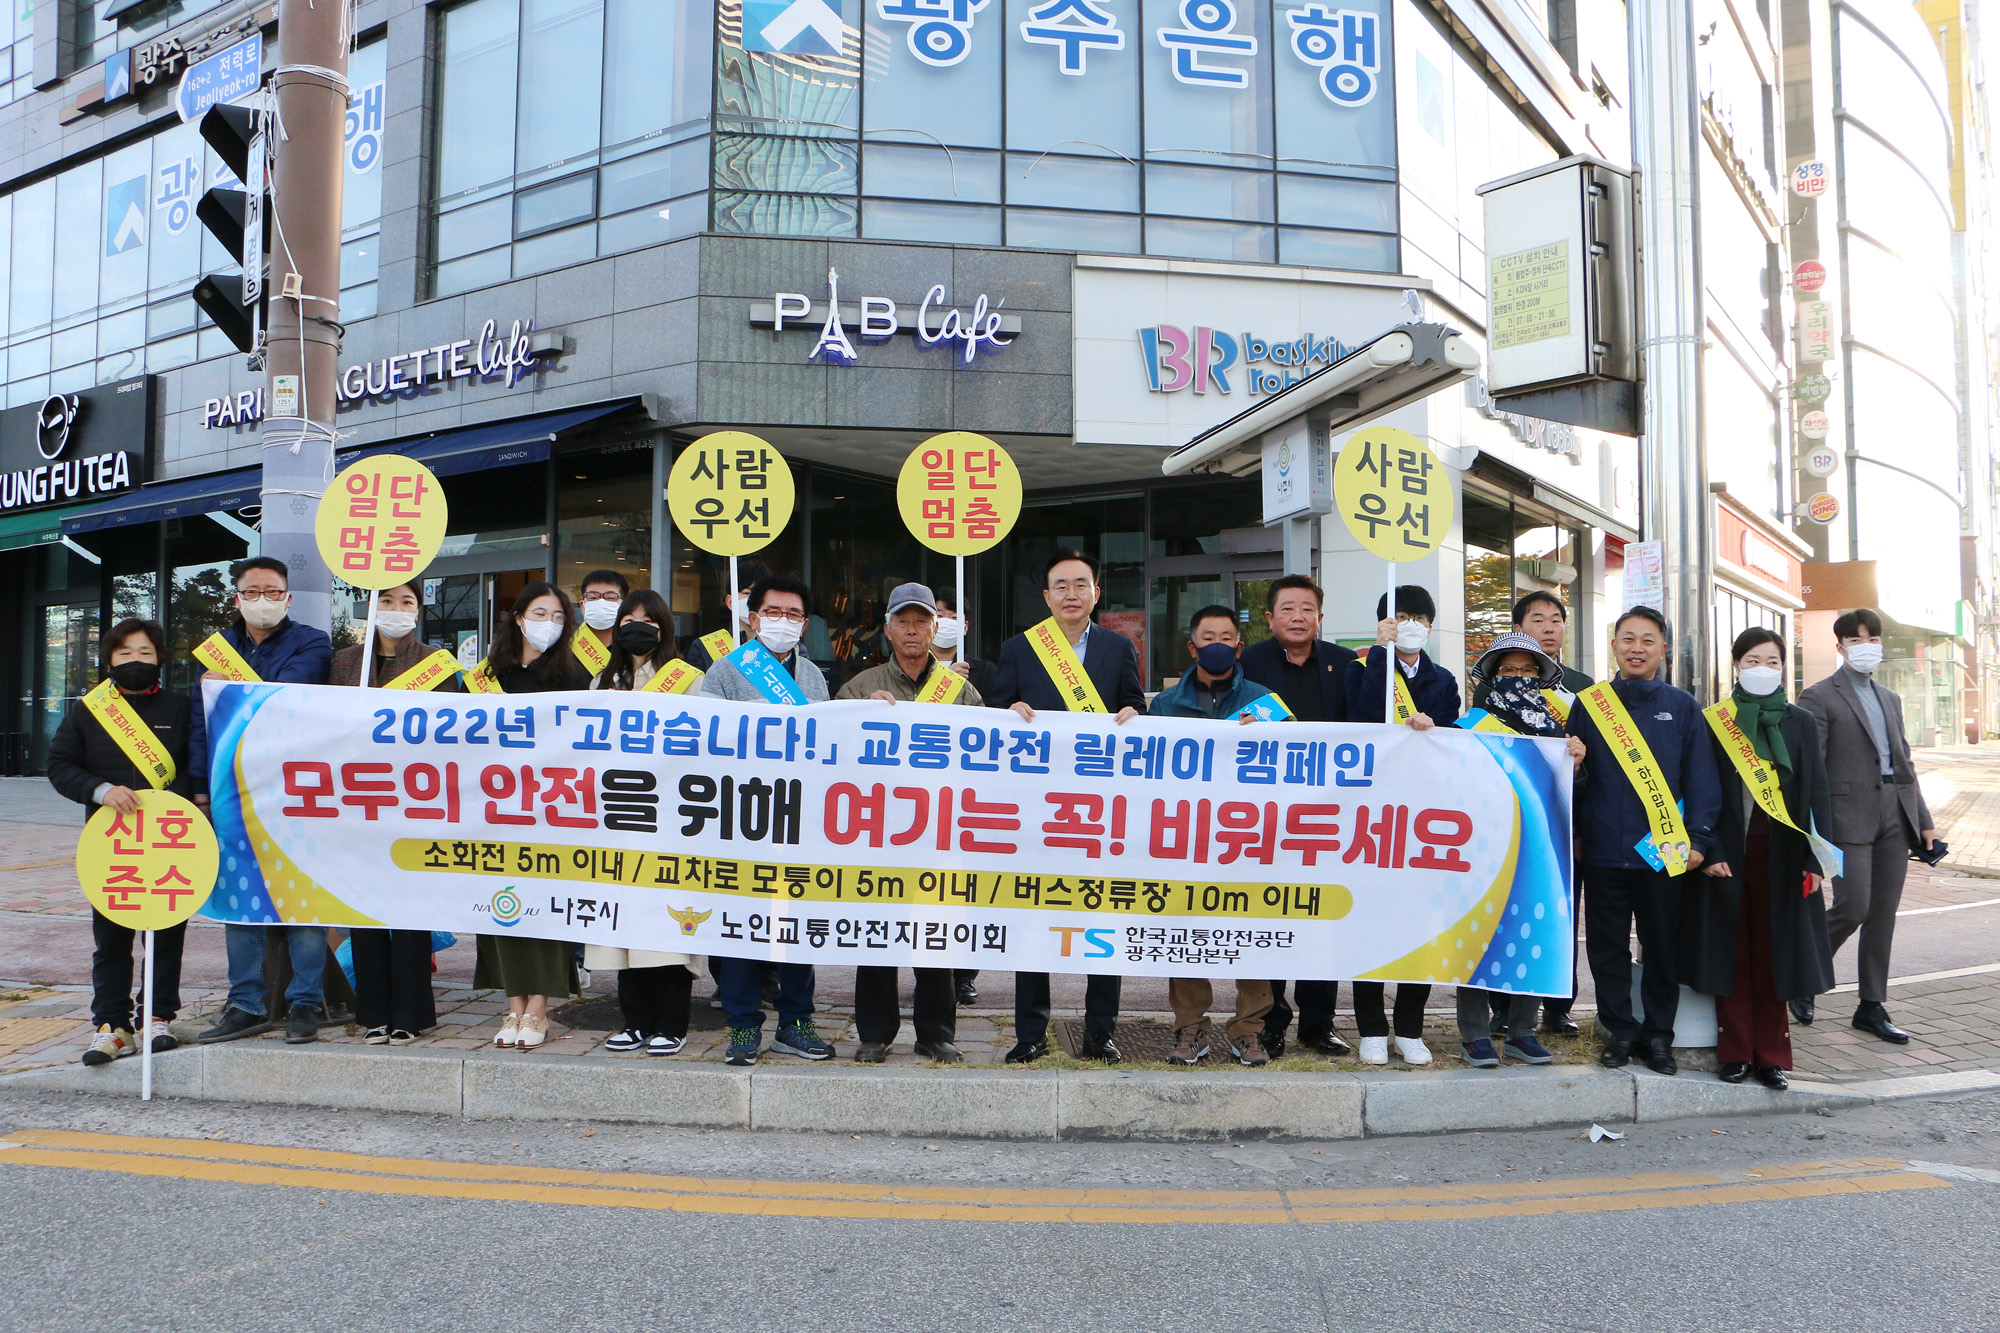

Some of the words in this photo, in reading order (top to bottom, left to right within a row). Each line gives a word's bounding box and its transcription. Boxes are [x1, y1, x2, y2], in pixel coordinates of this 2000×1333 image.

[219, 43, 257, 80] 전력로
[195, 71, 256, 111] Jeollyeok-ro
[1795, 162, 1824, 180] 성형
[1796, 178, 1826, 193] 비만
[1500, 255, 1524, 269] CCTV
[1526, 250, 1540, 263] 설치
[1543, 245, 1559, 259] 안내
[1534, 279, 1549, 290] 사거리
[917, 284, 1013, 363] Café
[1807, 303, 1830, 358] 우리약국
[205, 387, 266, 428] PARI
[337, 339, 472, 402] GUETTE
[476, 318, 537, 389] Café
[1137, 324, 1240, 395] BR
[1800, 383, 1830, 399] 비빔밥
[498, 450, 528, 461] SANDWICH
[1315, 430, 1325, 456] 다기능
[1813, 455, 1832, 468] BR
[83, 450, 130, 493] TEA
[690, 448, 774, 490] 사람
[921, 448, 1001, 491] 일단
[1277, 477, 1293, 497] 나주시
[1355, 441, 1434, 496] 사람
[345, 472, 429, 518] 일단
[1811, 498, 1836, 510] BURGER
[1812, 503, 1837, 517] KING
[690, 497, 771, 539] 우선
[922, 496, 1001, 539] 멈춤
[1354, 493, 1430, 549] 우선
[339, 521, 422, 573] 멈춤
[202, 640, 250, 681] 불법주·정
[372, 705, 536, 749] 2022년
[857, 720, 1051, 775] 교통안전
[1073, 732, 1215, 782] 릴레이
[1235, 739, 1375, 787] 캠페인
[282, 761, 460, 823] 모두의
[480, 764, 660, 833] 안전을
[678, 773, 802, 845] 위해
[823, 781, 1021, 854] 여기는
[1041, 791, 1128, 859] 꼭!
[1148, 797, 1473, 873] 비워두세요
[1636, 765, 1675, 836] 하지맙시다
[105, 809, 196, 855] 신호
[102, 865, 195, 912] 준수
[424, 841, 506, 873] 소화전
[517, 848, 561, 875] 5m
[573, 847, 623, 881] 이내
[631, 850, 647, 884] /
[654, 854, 740, 891] 교차로
[752, 863, 843, 899] 모퉁이
[856, 869, 904, 898] 5m
[918, 872, 978, 904] 이내
[989, 874, 1002, 905] /
[1014, 874, 1171, 912] 버스정류장
[1184, 884, 1249, 913] 10m
[1263, 885, 1321, 917] 이내
[550, 896, 619, 931] 나주시
[720, 911, 1008, 954] 노인교통안전지킴이회
[1049, 926, 1116, 958] TS
[1124, 945, 1242, 965] 광주전남본부
[1125, 926, 1295, 950] 한국교통안전공단
